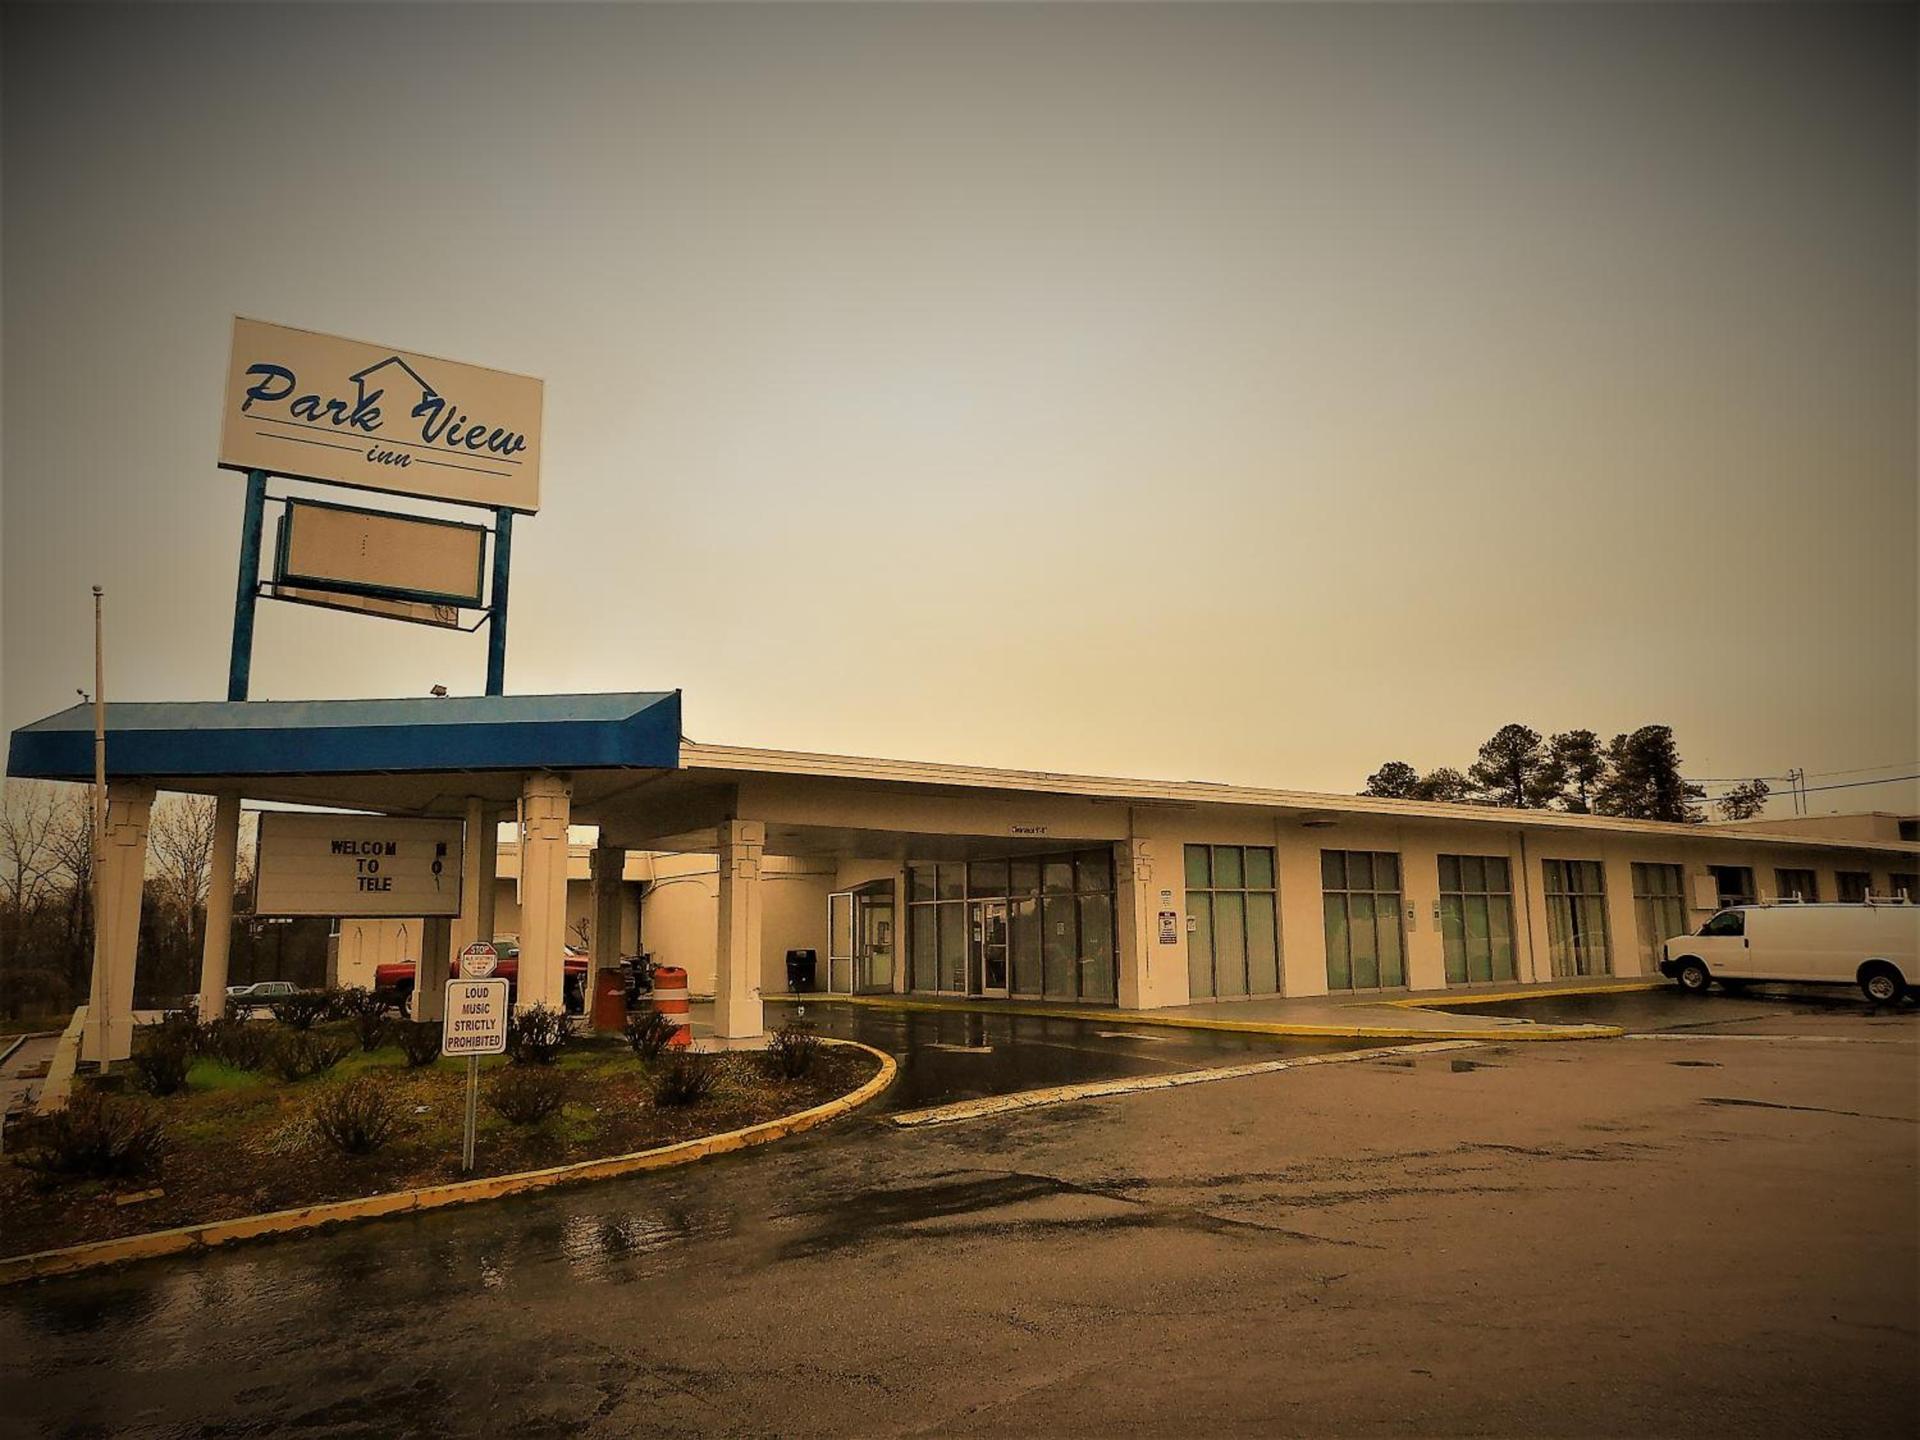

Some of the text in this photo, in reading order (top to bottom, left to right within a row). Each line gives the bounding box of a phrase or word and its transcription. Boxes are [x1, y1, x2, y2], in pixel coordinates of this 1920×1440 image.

[241, 363, 527, 456] Park View
[365, 444, 413, 469] inn
[331, 841, 396, 855] WELCOM
[356, 859, 379, 873] TO
[357, 877, 392, 891] TELE
[470, 946, 489, 954] STOP
[465, 988, 488, 998] LOUD
[462, 1003, 489, 1014] MUSIC
[454, 1018, 496, 1031] STRICTLY
[447, 1034, 500, 1048] PROHIBITED
